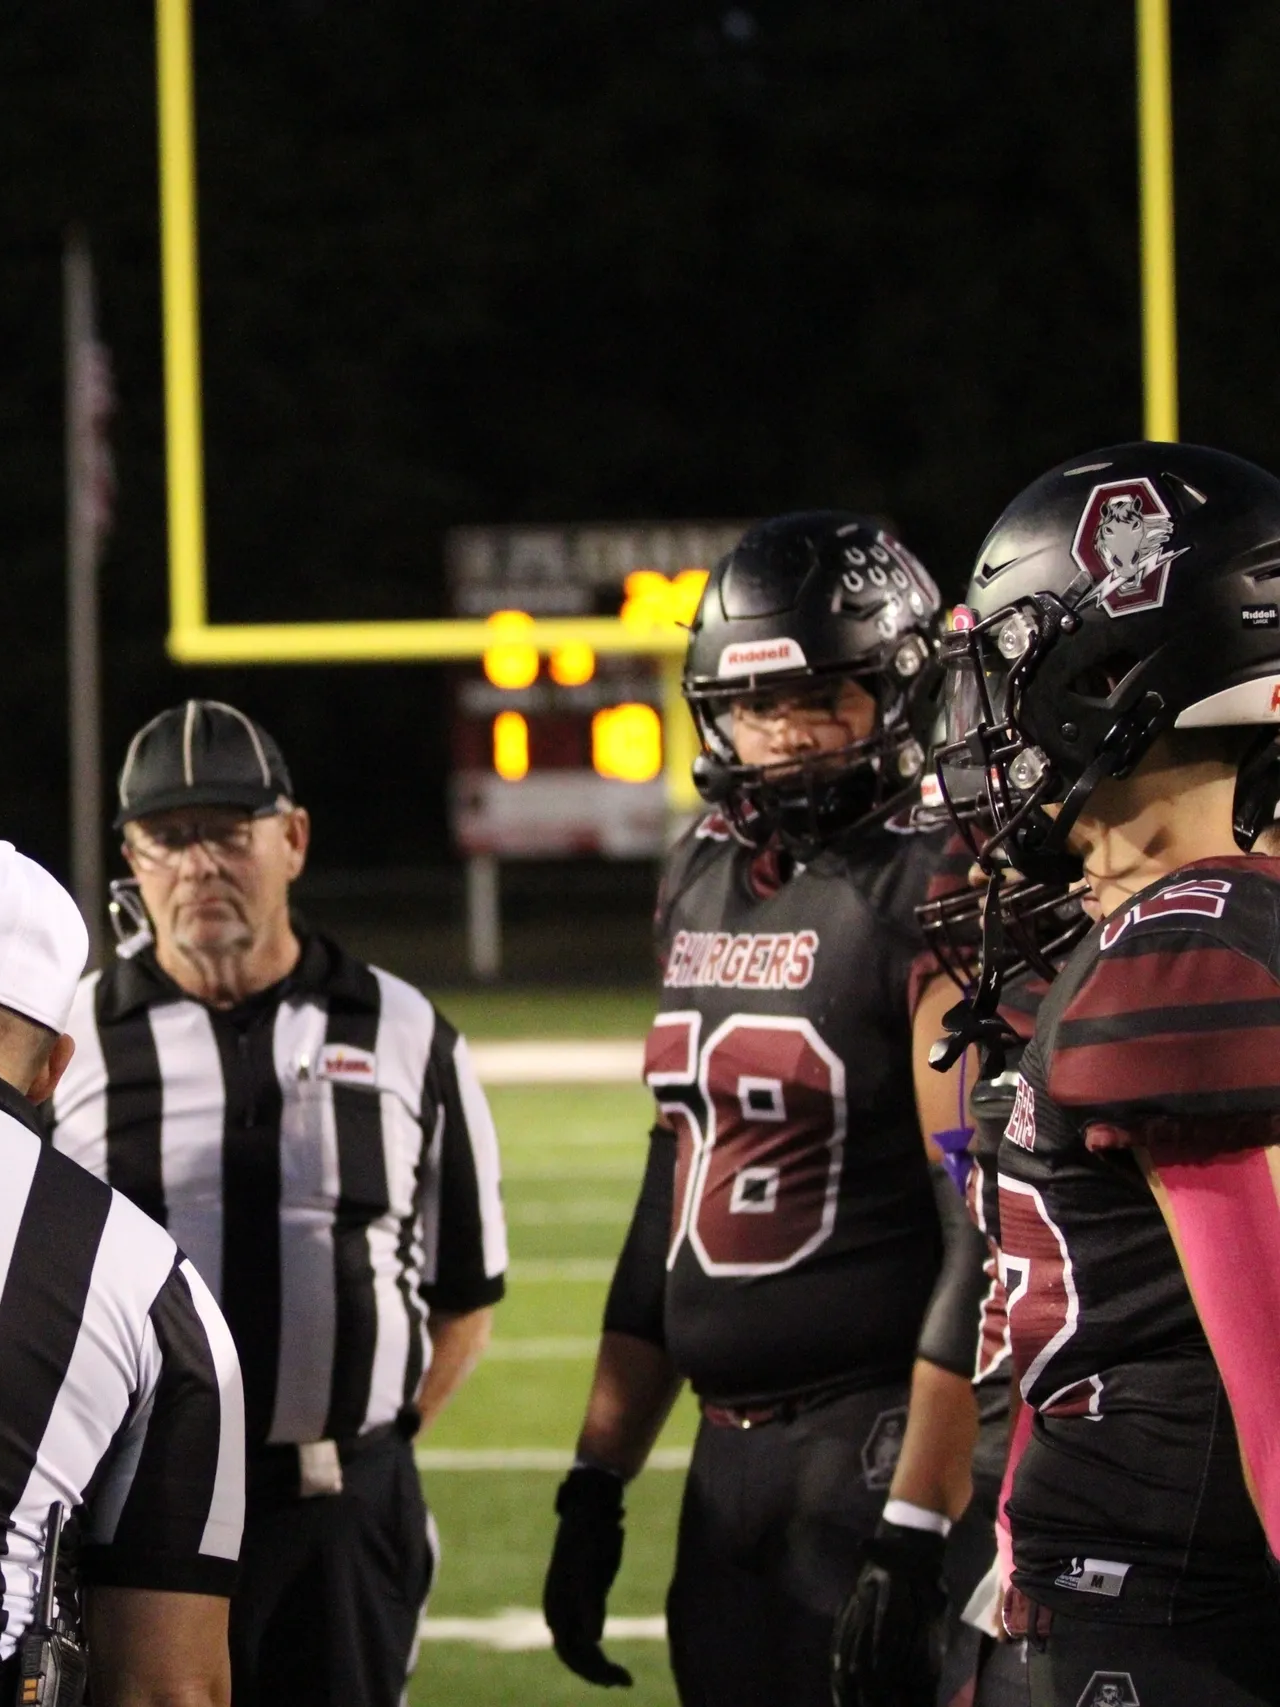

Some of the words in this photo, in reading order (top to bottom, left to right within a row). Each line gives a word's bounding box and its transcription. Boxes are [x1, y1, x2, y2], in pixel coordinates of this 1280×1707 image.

[1242, 610, 1276, 620] Riddell
[728, 642, 790, 665] Riddell
[663, 929, 819, 990] CHARGERS
[643, 1010, 848, 1278] 58
